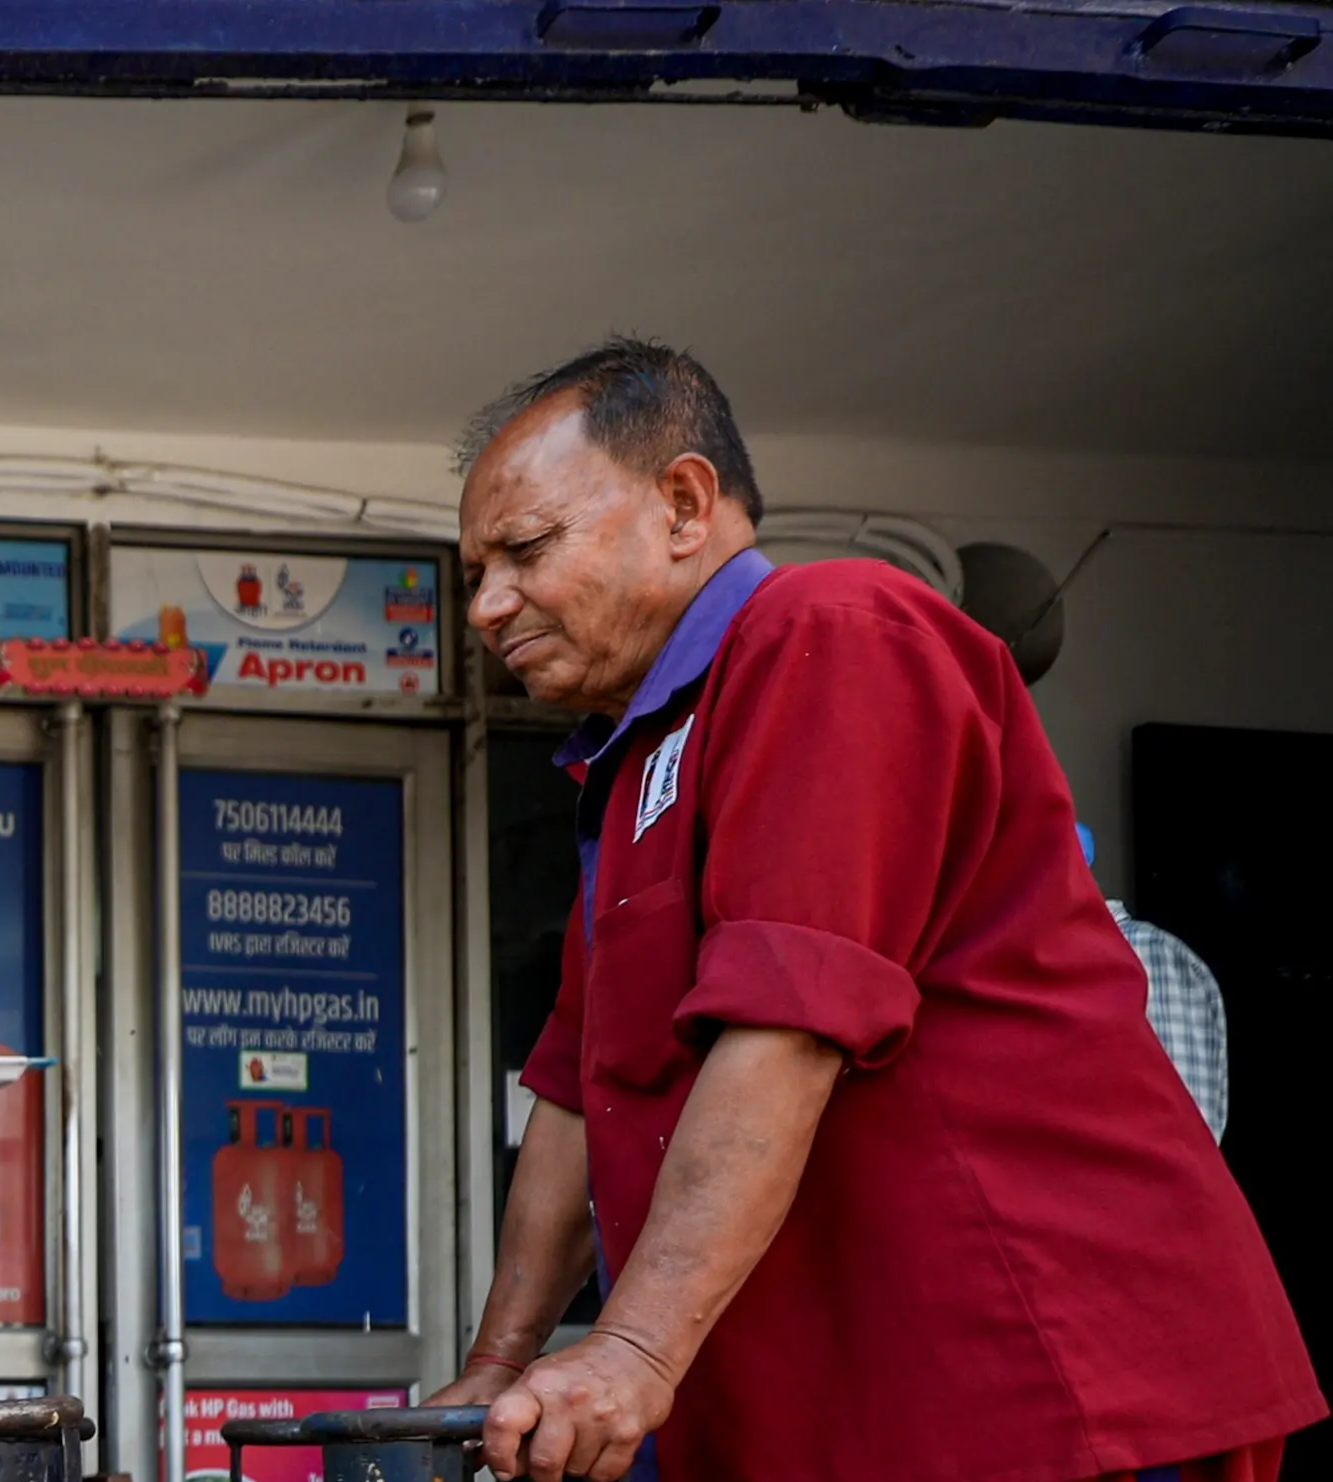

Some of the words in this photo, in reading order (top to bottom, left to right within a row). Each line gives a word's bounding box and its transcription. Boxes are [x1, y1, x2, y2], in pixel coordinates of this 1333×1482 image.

[237, 650, 368, 688] Apron
[214, 798, 344, 838] 7506114444
[208, 888, 351, 927] 8888823456
[182, 986, 380, 1025] www.myhpgas.in
[201, 1398, 225, 1419] HP
[226, 1399, 256, 1419] Gas
[259, 1398, 294, 1420] with
